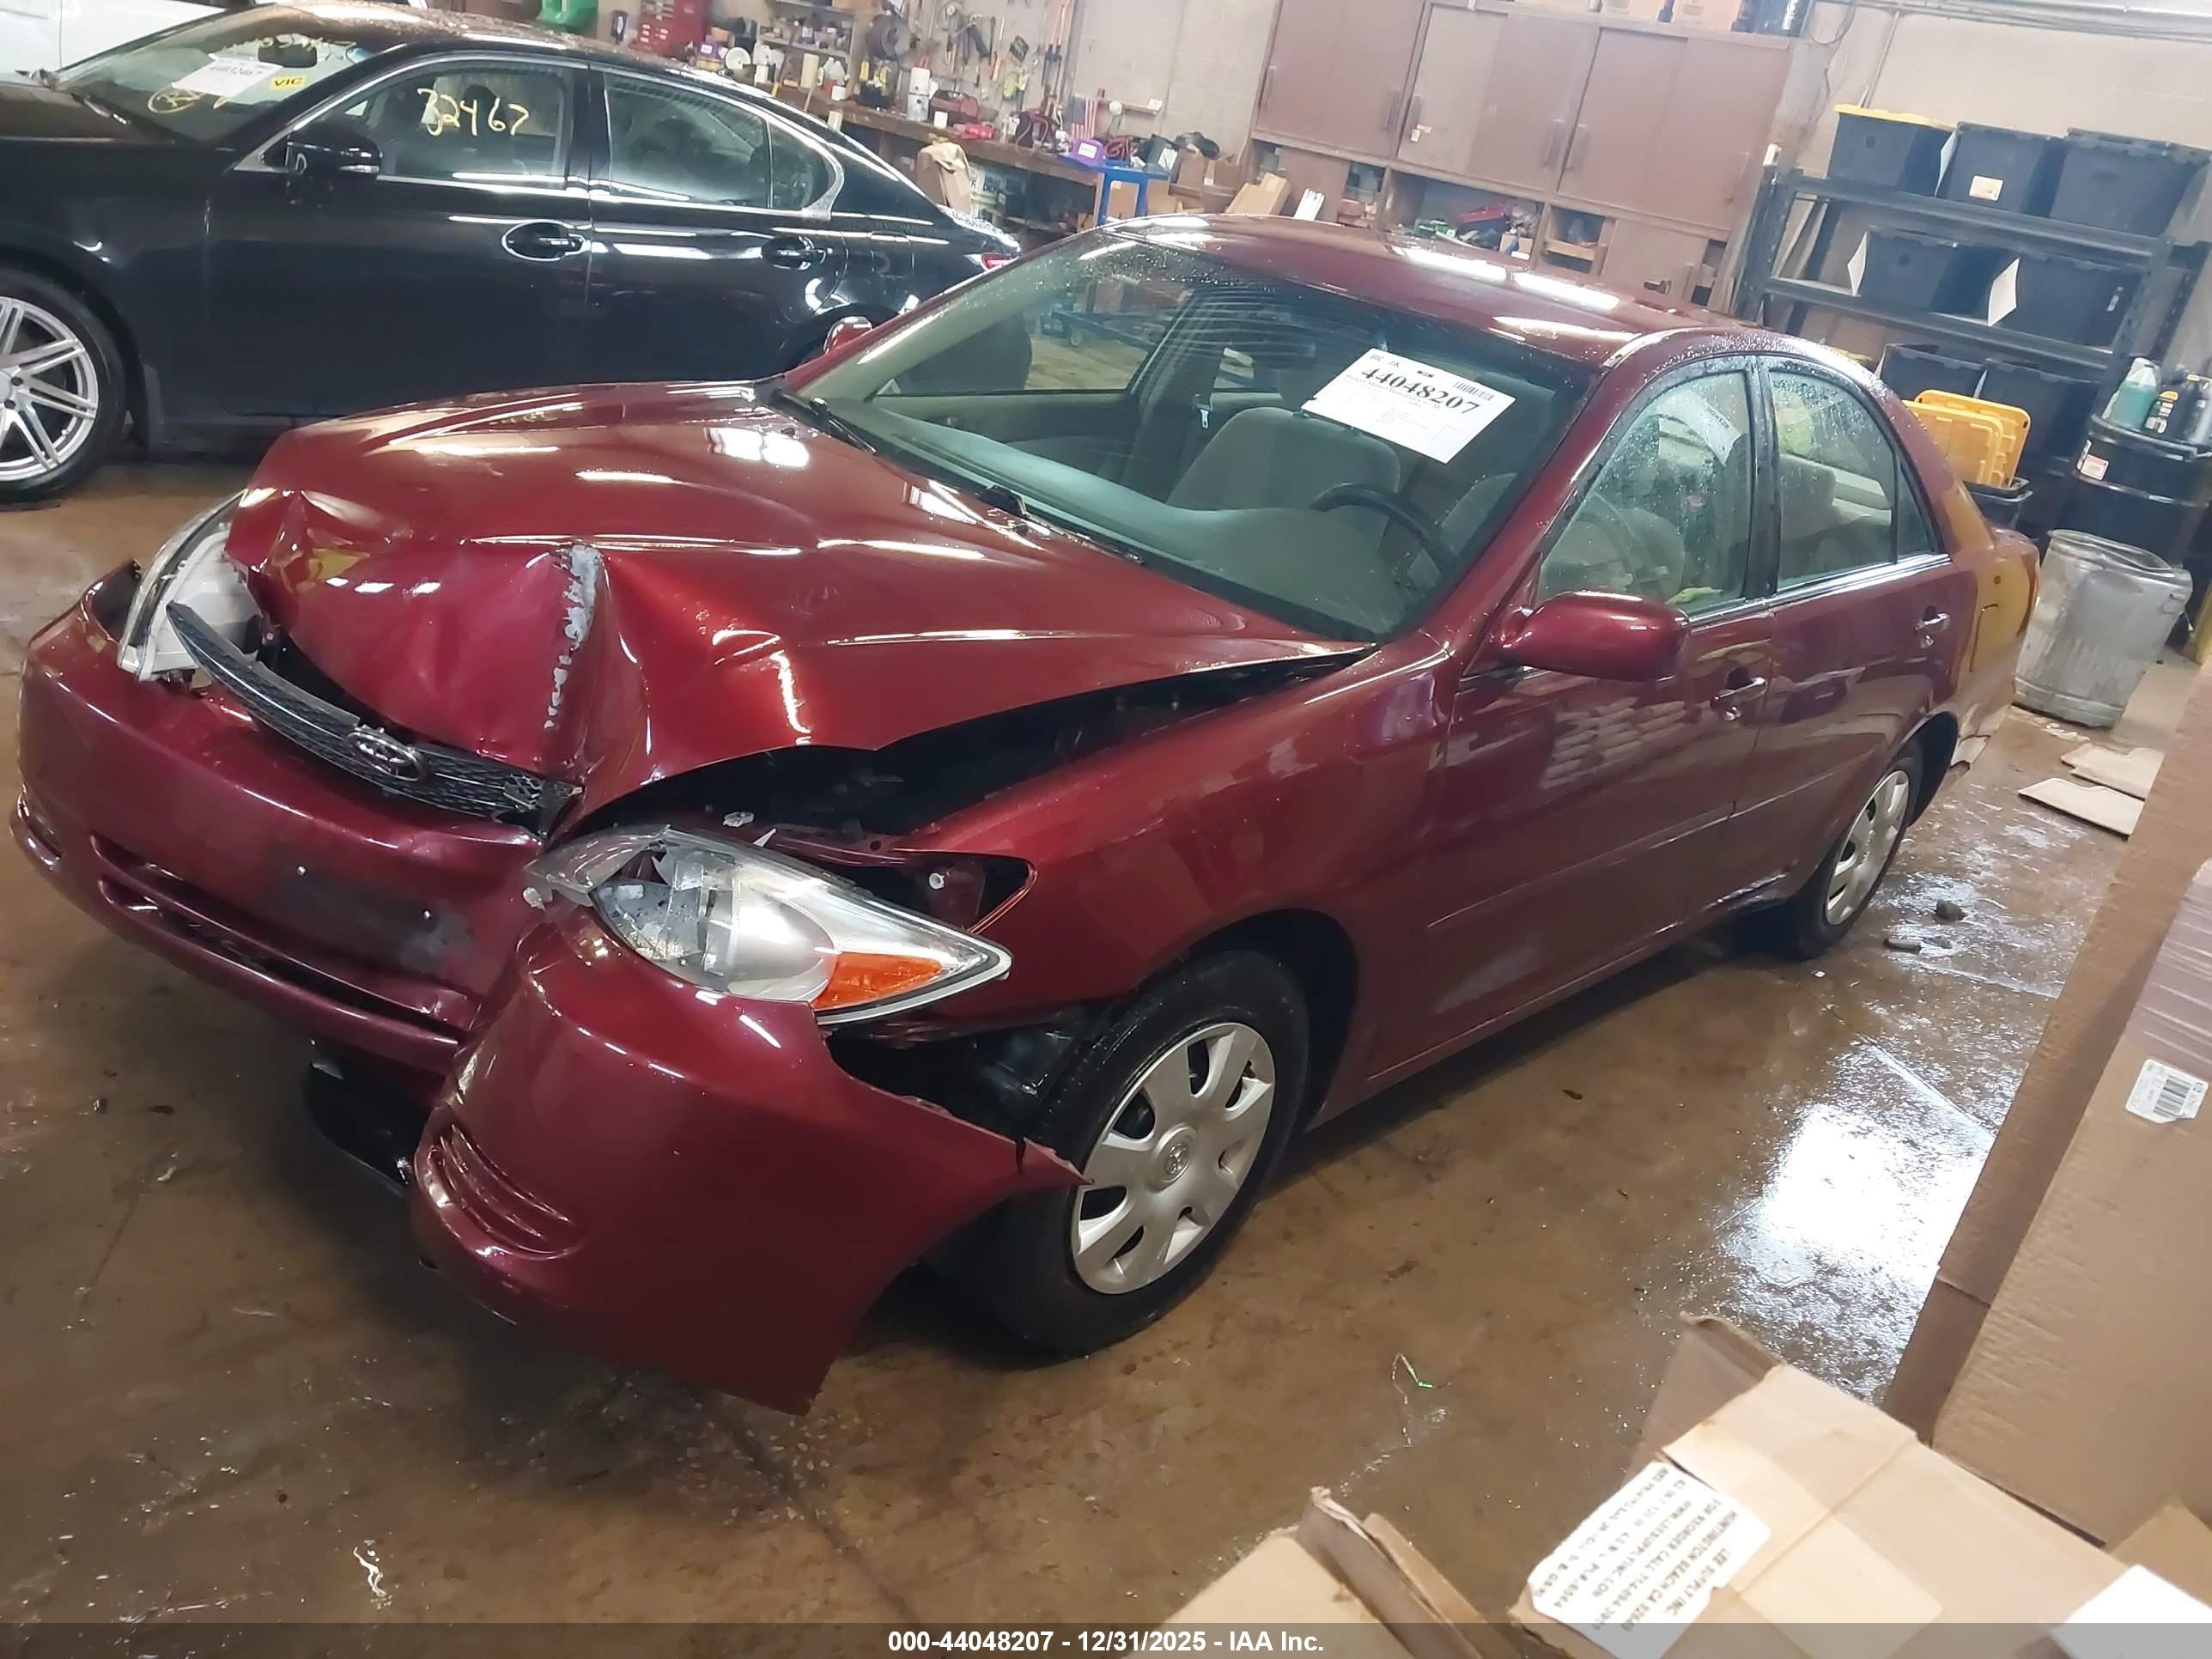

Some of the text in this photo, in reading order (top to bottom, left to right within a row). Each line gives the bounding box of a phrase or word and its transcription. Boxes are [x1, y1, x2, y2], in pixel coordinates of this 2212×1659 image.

[274, 77, 302, 86] VIC
[416, 88, 529, 136] 32467
[1361, 368, 1481, 414] 44048207
[1645, 1548, 1668, 1572] CALL
[1712, 1547, 1730, 1566] LEE
[1659, 1559, 1689, 1590] BEACH
[1646, 1588, 1662, 1604] CA
